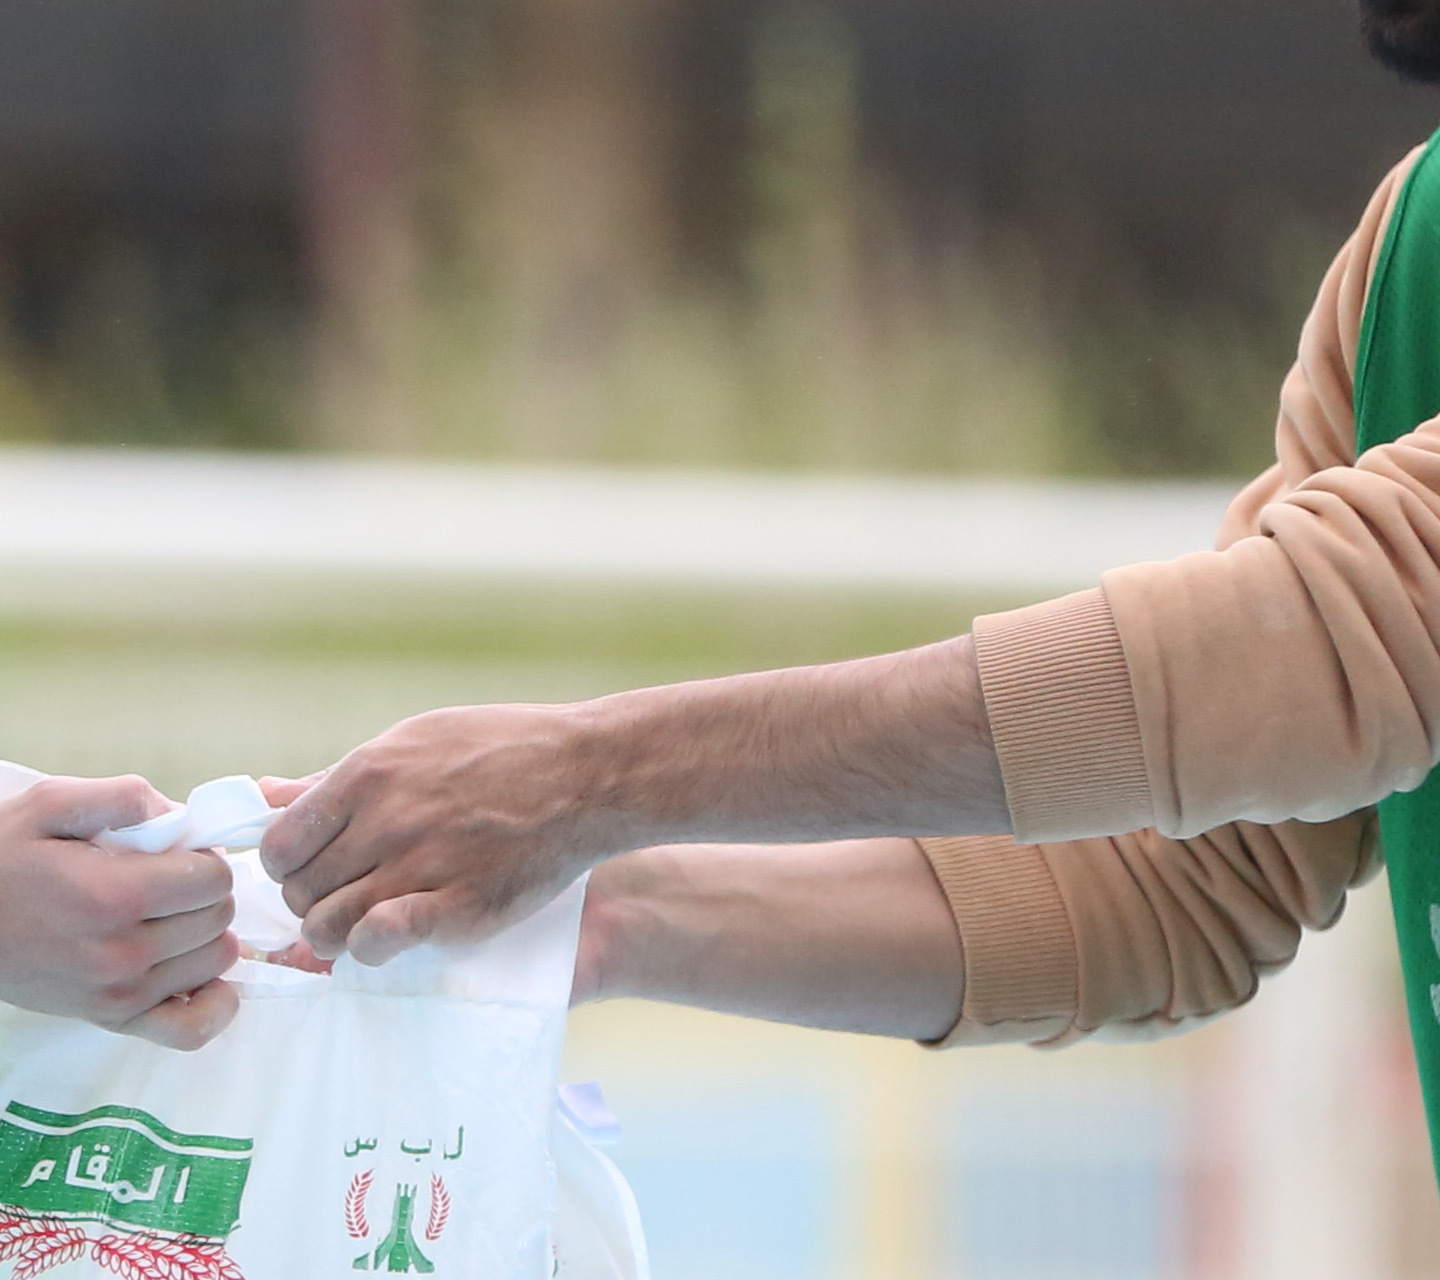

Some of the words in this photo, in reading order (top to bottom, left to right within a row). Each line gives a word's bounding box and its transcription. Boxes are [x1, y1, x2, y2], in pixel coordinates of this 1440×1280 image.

[343, 1135, 378, 1158] س
[400, 1137, 432, 1163] ب
[21, 1142, 190, 1204] المقام
